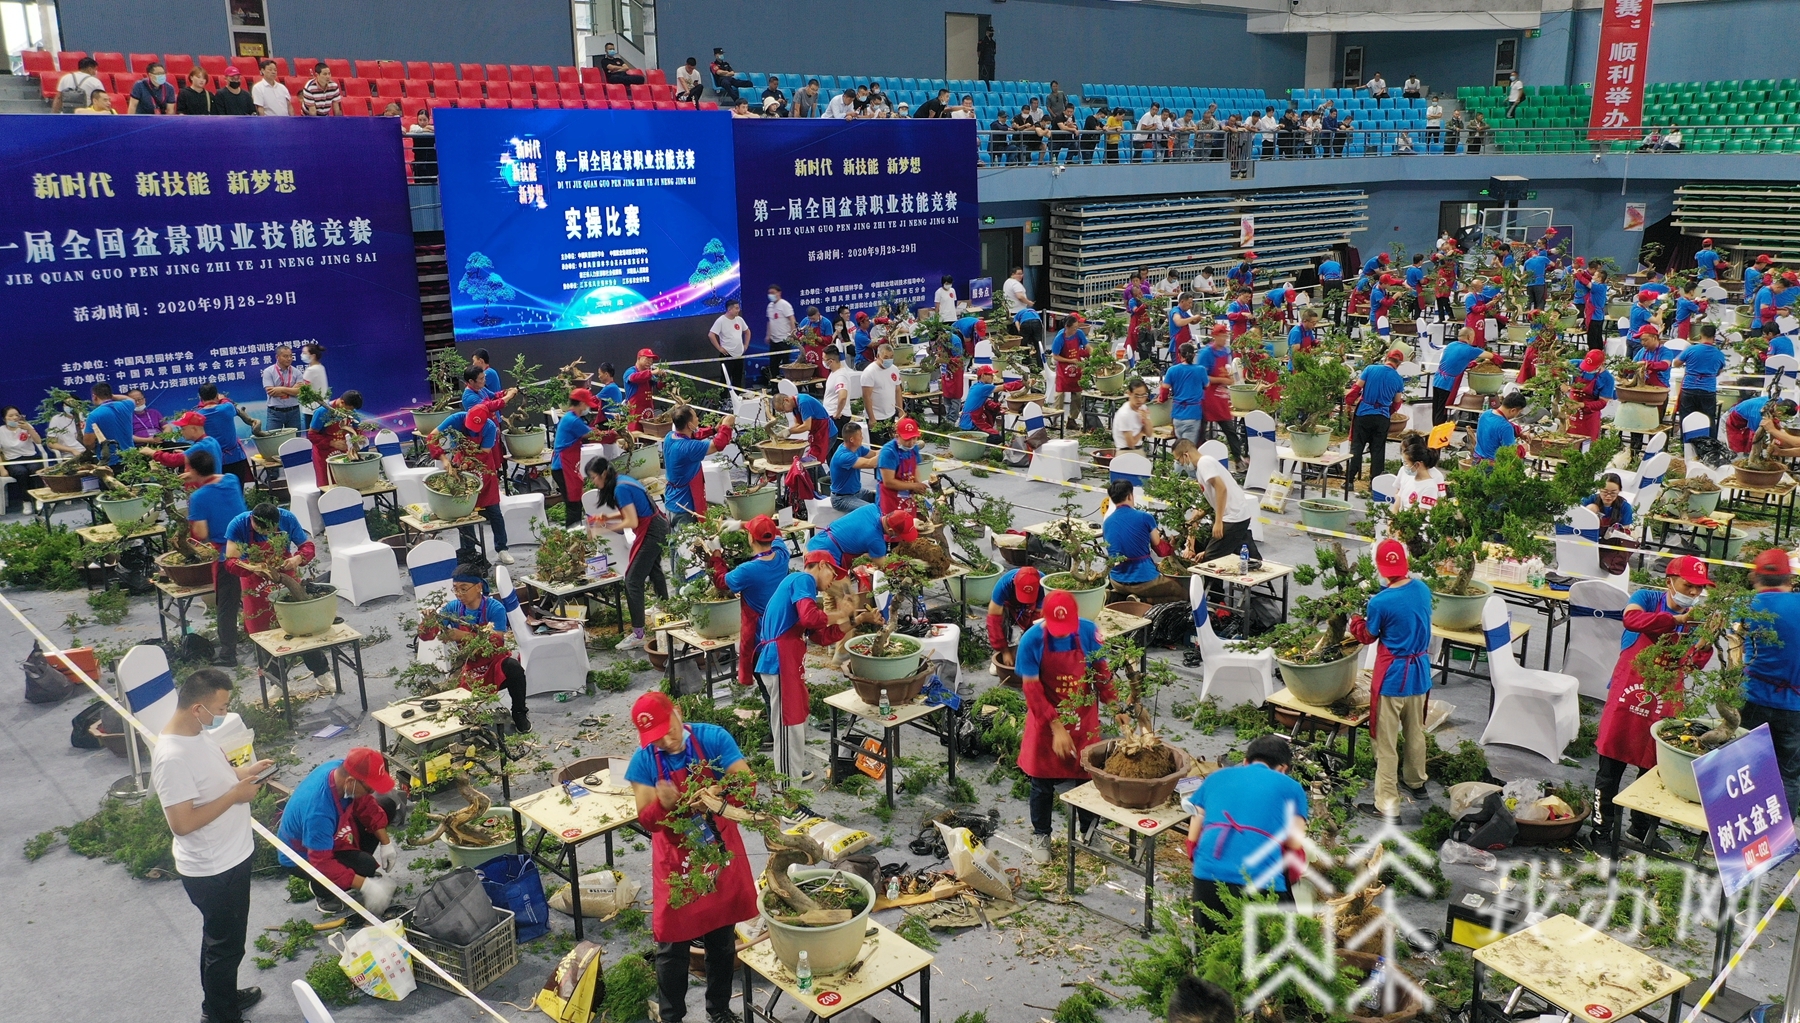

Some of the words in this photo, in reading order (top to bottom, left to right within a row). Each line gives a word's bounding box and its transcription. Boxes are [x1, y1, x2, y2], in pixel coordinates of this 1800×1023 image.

[555, 148, 696, 173] 第一届全国盆景职业技能竞赛
[794, 157, 833, 177] 新时代
[843, 157, 879, 176] 新技能
[887, 156, 921, 174] 新梦想
[33, 172, 115, 199] 新时代
[135, 171, 211, 197] 新技能
[227, 169, 296, 195] 新梦想
[753, 190, 958, 222] 第一届全国盆景职业技能竞赛
[564, 204, 640, 240] 实操比赛
[754, 229, 764, 237] DI
[766, 228, 775, 236] YI
[778, 227, 791, 236] JIE
[794, 226, 815, 236] QUAN
[818, 225, 834, 233] GUO
[836, 223, 851, 232] PEN
[853, 222, 871, 230] JING
[873, 221, 886, 229] ZHI
[888, 220, 897, 228] YE
[899, 220, 907, 228] JI
[908, 218, 927, 227] NENG
[929, 217, 946, 225] JING
[947, 216, 959, 224] SAI
[5, 274, 34, 285] JIE
[40, 270, 84, 284] QUAN
[91, 268, 123, 280] GUO
[130, 266, 159, 278] PEN
[166, 263, 200, 276] JING
[206, 261, 231, 273] ZHI
[237, 260, 254, 271] YE
[260, 259, 273, 270] JI
[278, 257, 315, 269] NENG
[320, 254, 351, 265] JING
[356, 252, 378, 263] SAI
[972, 286, 990, 299] 服务点
[1725, 764, 1756, 799] C区
[1717, 794, 1783, 854] 树木盆景
[818, 993, 839, 1005] 002
